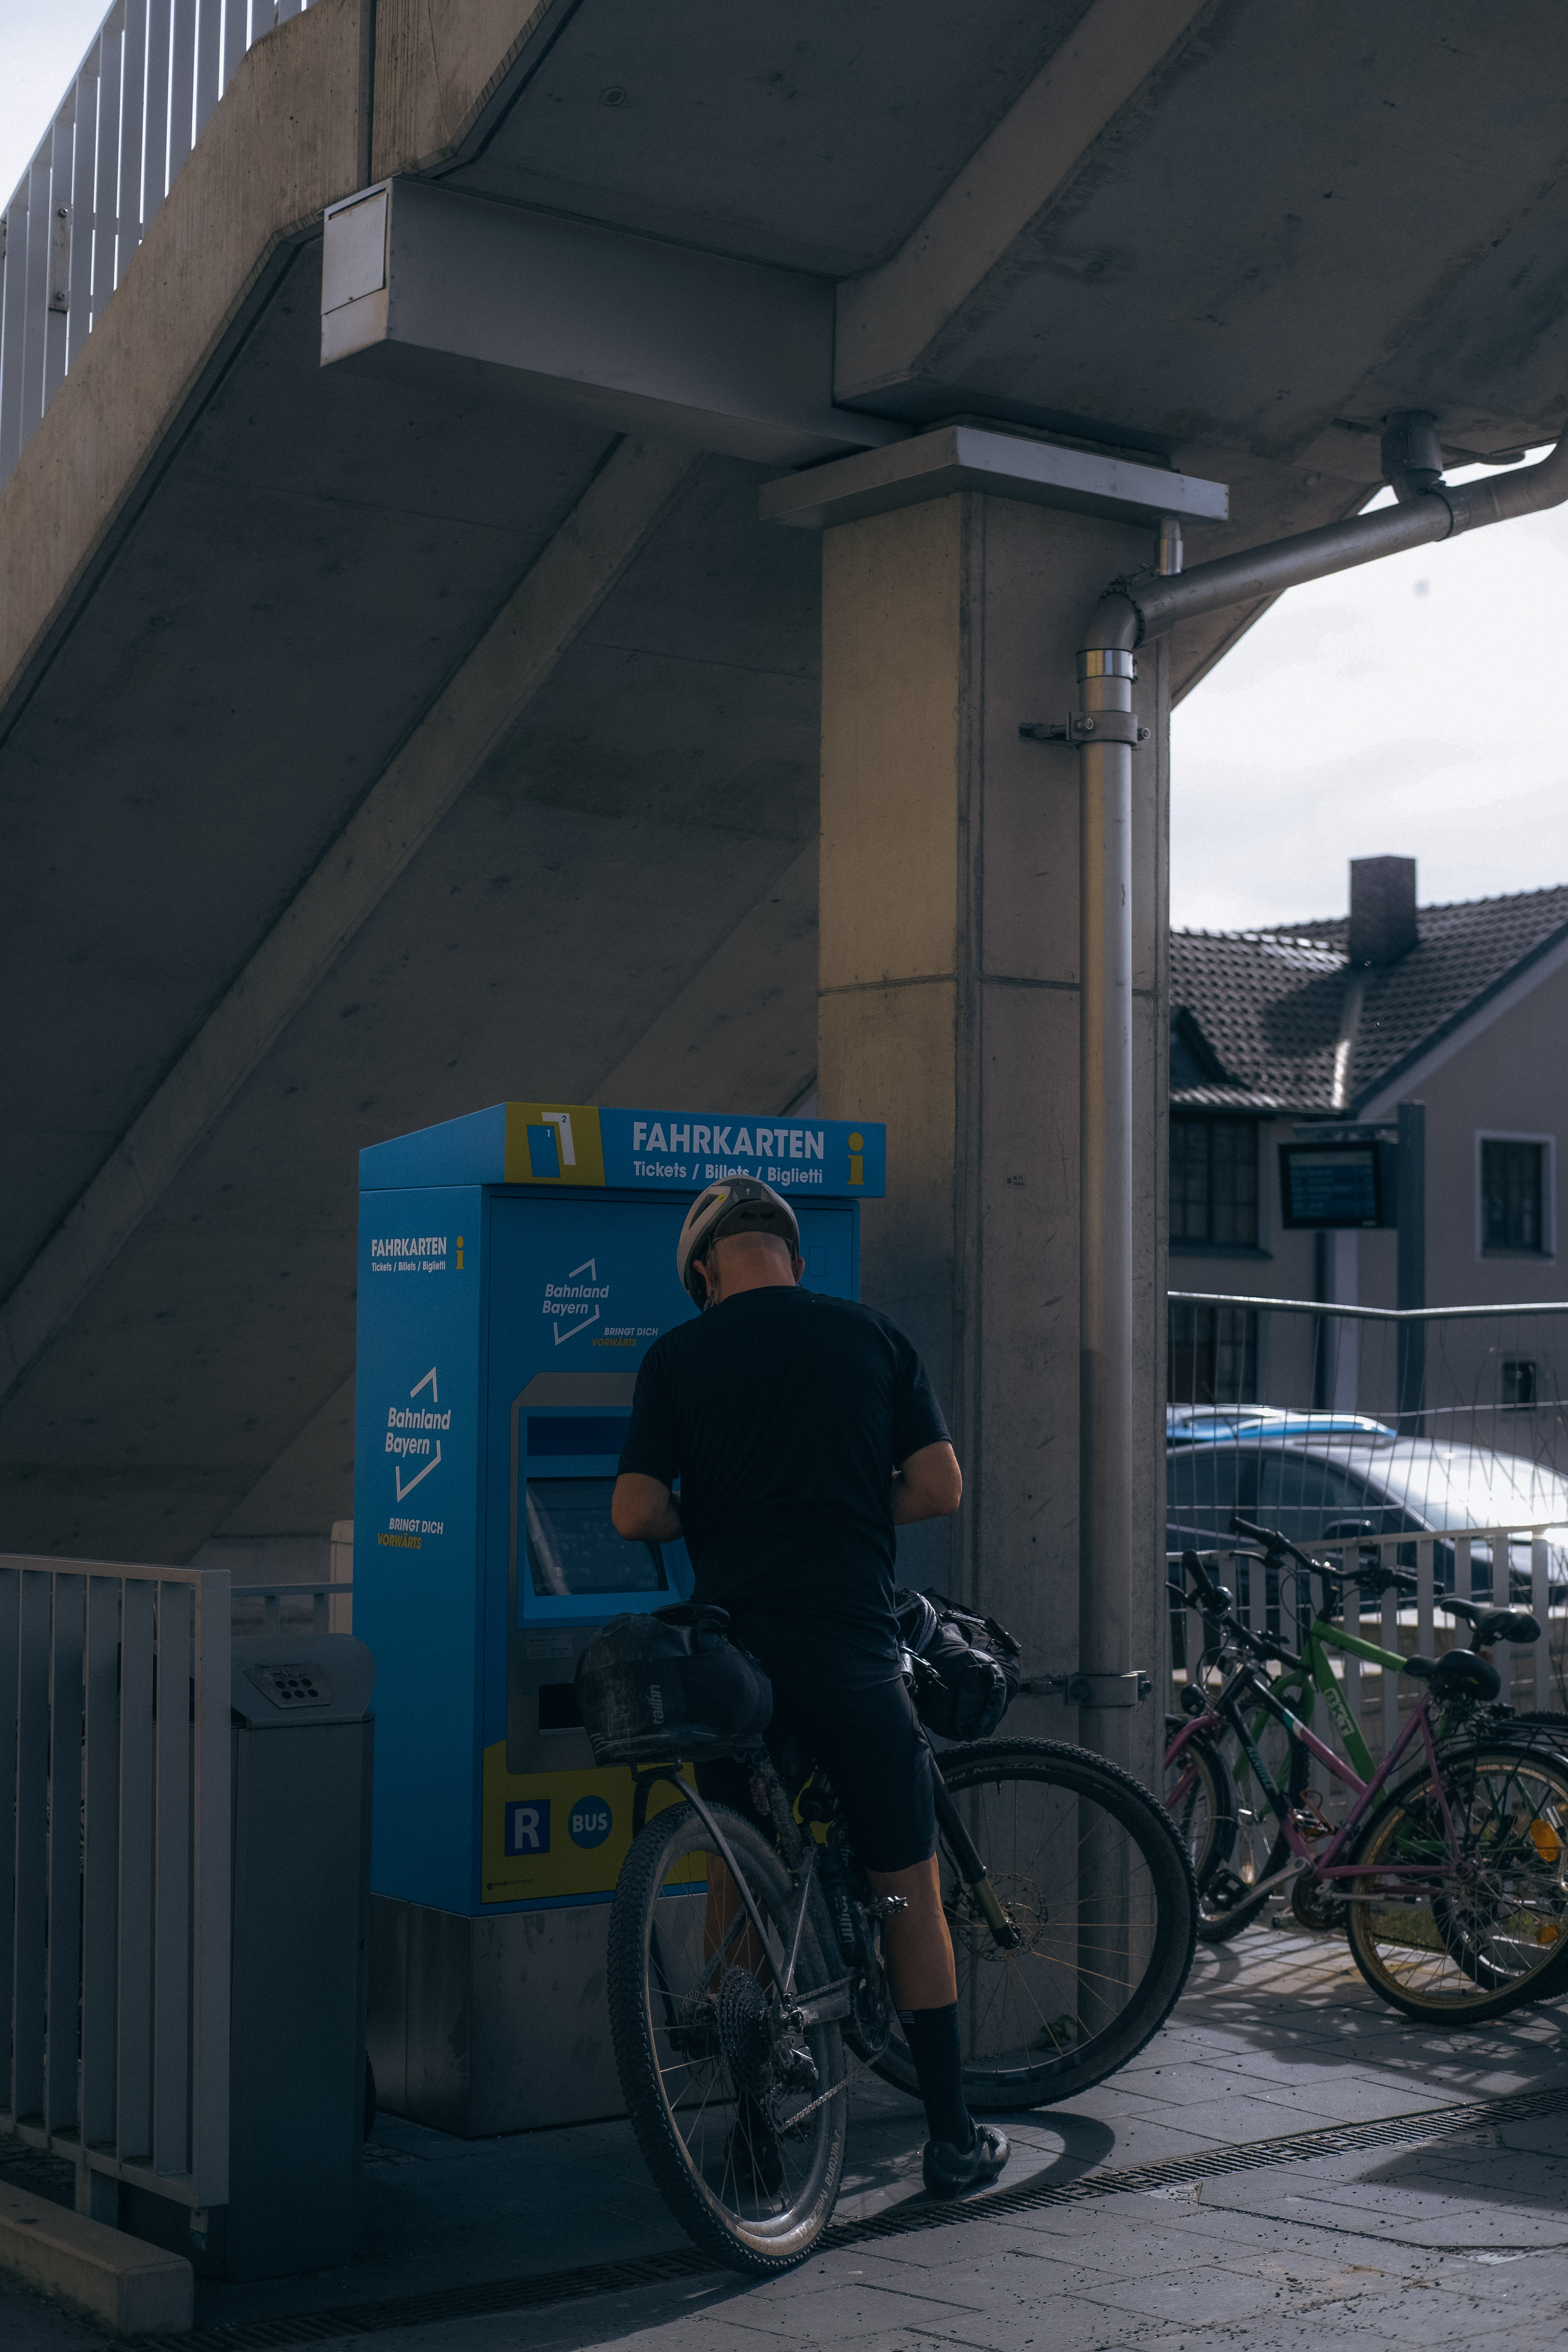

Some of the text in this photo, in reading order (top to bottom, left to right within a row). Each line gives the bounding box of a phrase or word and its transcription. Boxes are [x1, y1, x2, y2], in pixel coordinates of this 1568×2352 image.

[633, 1121, 824, 1159] FAHRKARTEN
[634, 1161, 687, 1178] Tickets
[705, 1164, 749, 1179] Billets
[767, 1167, 823, 1187] Biglietti
[372, 1237, 447, 1257] FAHRKARTEN
[372, 1262, 392, 1272] Tickets
[398, 1261, 416, 1271] Billets
[423, 1260, 446, 1273] Biglietti
[545, 1283, 609, 1298] Bahnland
[542, 1300, 588, 1317] Bayern
[592, 1336, 637, 1347] VORWÄRTS
[604, 1327, 658, 1336] BRINGT DICH
[388, 1407, 451, 1430] Bahnland
[385, 1432, 430, 1458] Bayern
[389, 1517, 444, 1535] BRINGT DICH
[377, 1532, 422, 1550] VORWÄRTS
[646, 1684, 663, 1724] tailfin
[514, 1807, 540, 1849] R
[572, 1813, 608, 1833] BUS
